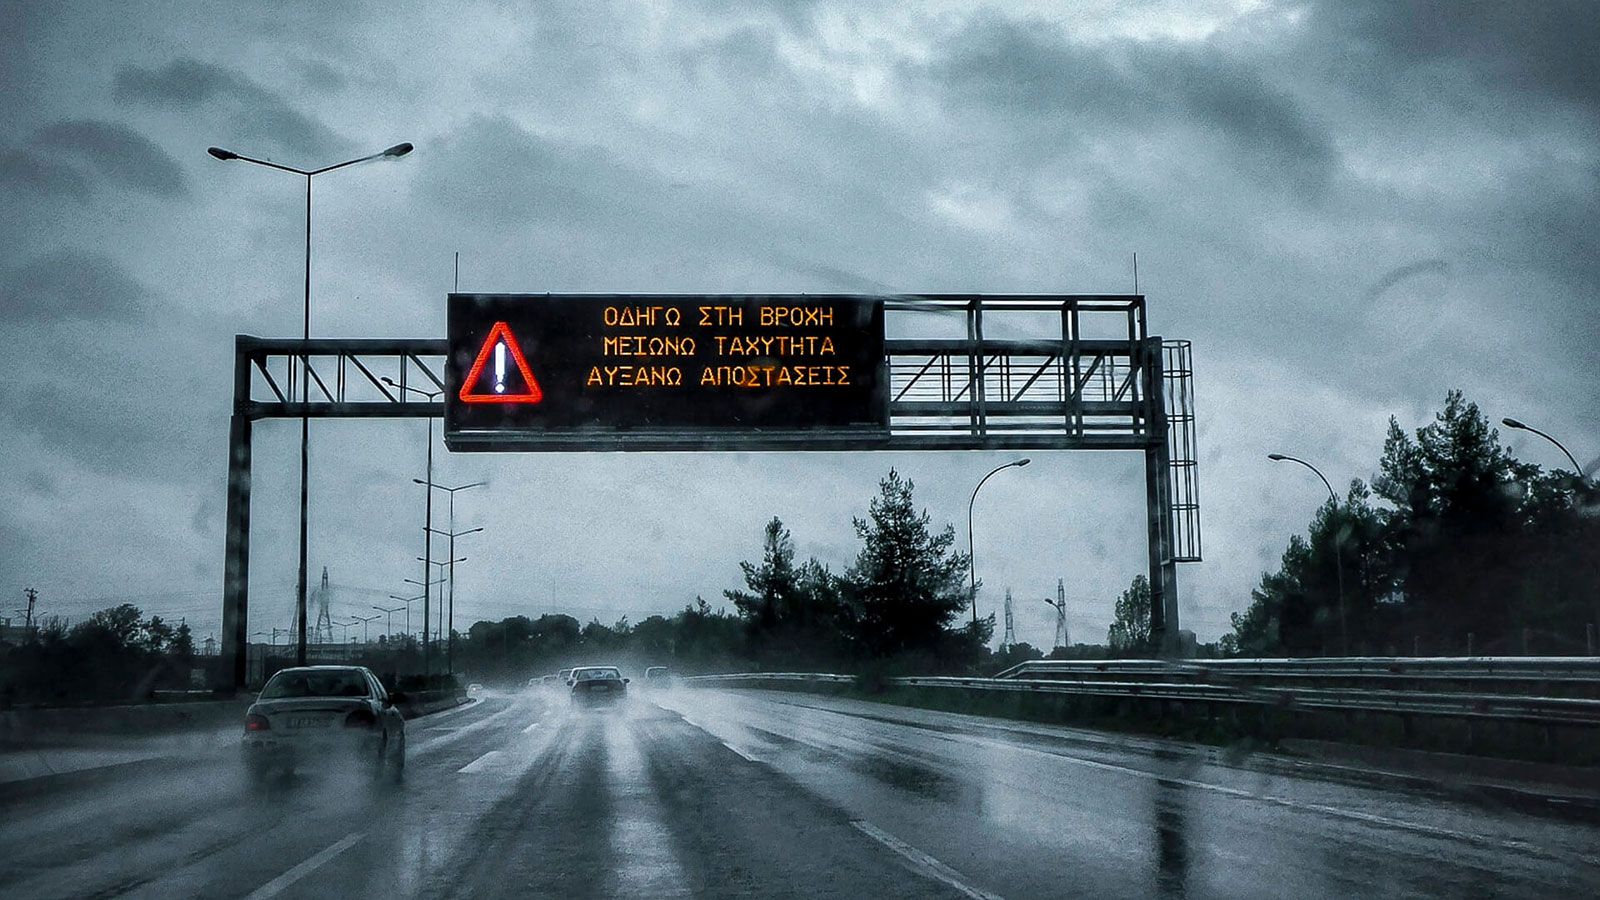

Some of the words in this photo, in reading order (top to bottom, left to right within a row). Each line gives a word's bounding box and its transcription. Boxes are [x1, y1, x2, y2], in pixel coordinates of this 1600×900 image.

[604, 306, 681, 326] ΟΔΗΓΩ
[698, 306, 743, 326] ΣΤΗ
[760, 306, 834, 326] ΒΡΟΧΗ
[603, 336, 696, 356] ΜΕΙΩΝΩ
[714, 336, 836, 356] ΤΑΧΥΤΗΤΑ
[587, 366, 682, 386] ΑΥΞΑΝΩ
[700, 366, 850, 387] ΑΠΟΣΤΑΣΕΙΣ
